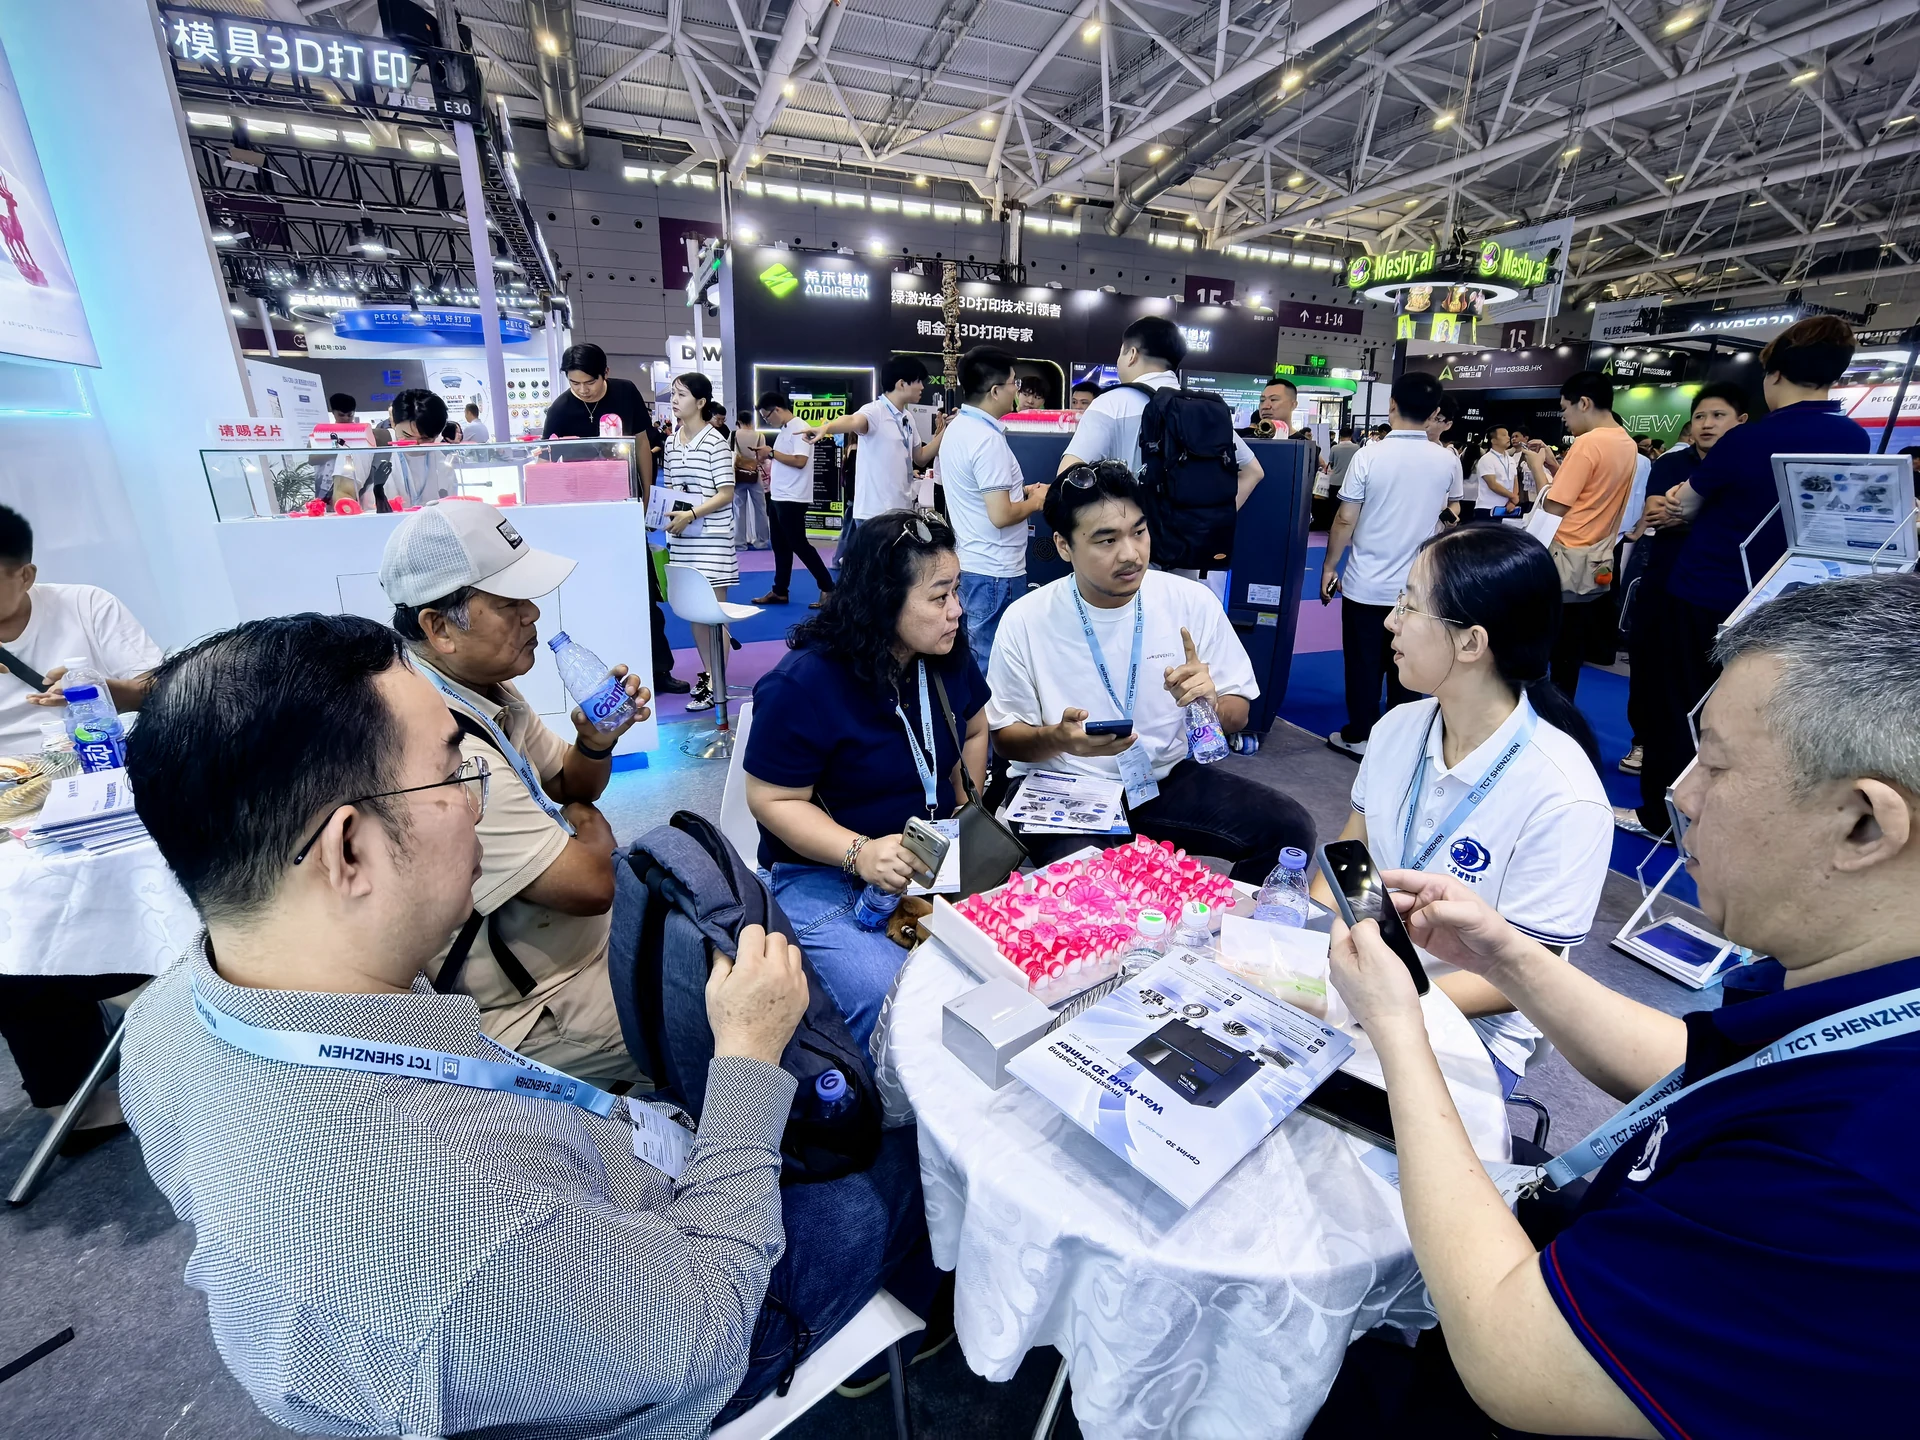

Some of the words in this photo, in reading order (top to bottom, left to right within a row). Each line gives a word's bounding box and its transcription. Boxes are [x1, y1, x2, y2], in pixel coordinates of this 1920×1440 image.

[173, 18, 409, 87] 模具3D打印
[444, 101, 471, 116] E30
[1374, 244, 1435, 281] Meshy.ai
[1501, 248, 1548, 286] Meshy.ai
[804, 269, 869, 288] 希禾增材
[804, 284, 869, 298] ADDIREEN
[890, 289, 1062, 318] 绿激光金3D打印技术引领者
[374, 313, 398, 321] PETG
[1324, 312, 1343, 327] 1-14
[1509, 328, 1526, 348] 15
[1453, 364, 1488, 372] CREALITY
[1506, 364, 1543, 373] 03388.HK
[1614, 359, 1640, 369] CREALITY
[796, 408, 824, 421] JOIN
[827, 408, 844, 421] US
[1622, 414, 1680, 433] NEW
[218, 424, 282, 437] 请赐名片
[1480, 777, 1494, 790] TCT
[1490, 742, 1521, 778] SHENZHEN
[1420, 833, 1445, 862] SHENZHEN
[1755, 1051, 1773, 1067] tct
[1785, 1032, 1818, 1055] TCT
[1821, 1000, 1920, 1043] SHENZHE
[318, 1043, 405, 1067] SHENZHEN
[1048, 1045, 1078, 1068] Casting
[1056, 1040, 1093, 1067] Printer
[406, 1057, 432, 1072] TCT
[1091, 1063, 1110, 1078] 3D
[513, 1075, 552, 1093] SHENZHEN
[551, 1082, 562, 1096] TCT
[1077, 1065, 1123, 1099] Investment
[1107, 1073, 1138, 1097] Mold
[1137, 1092, 1164, 1116] Wax
[1165, 1139, 1177, 1148] 3D
[1610, 1127, 1630, 1147] TCT
[1176, 1145, 1200, 1166] Cprint
